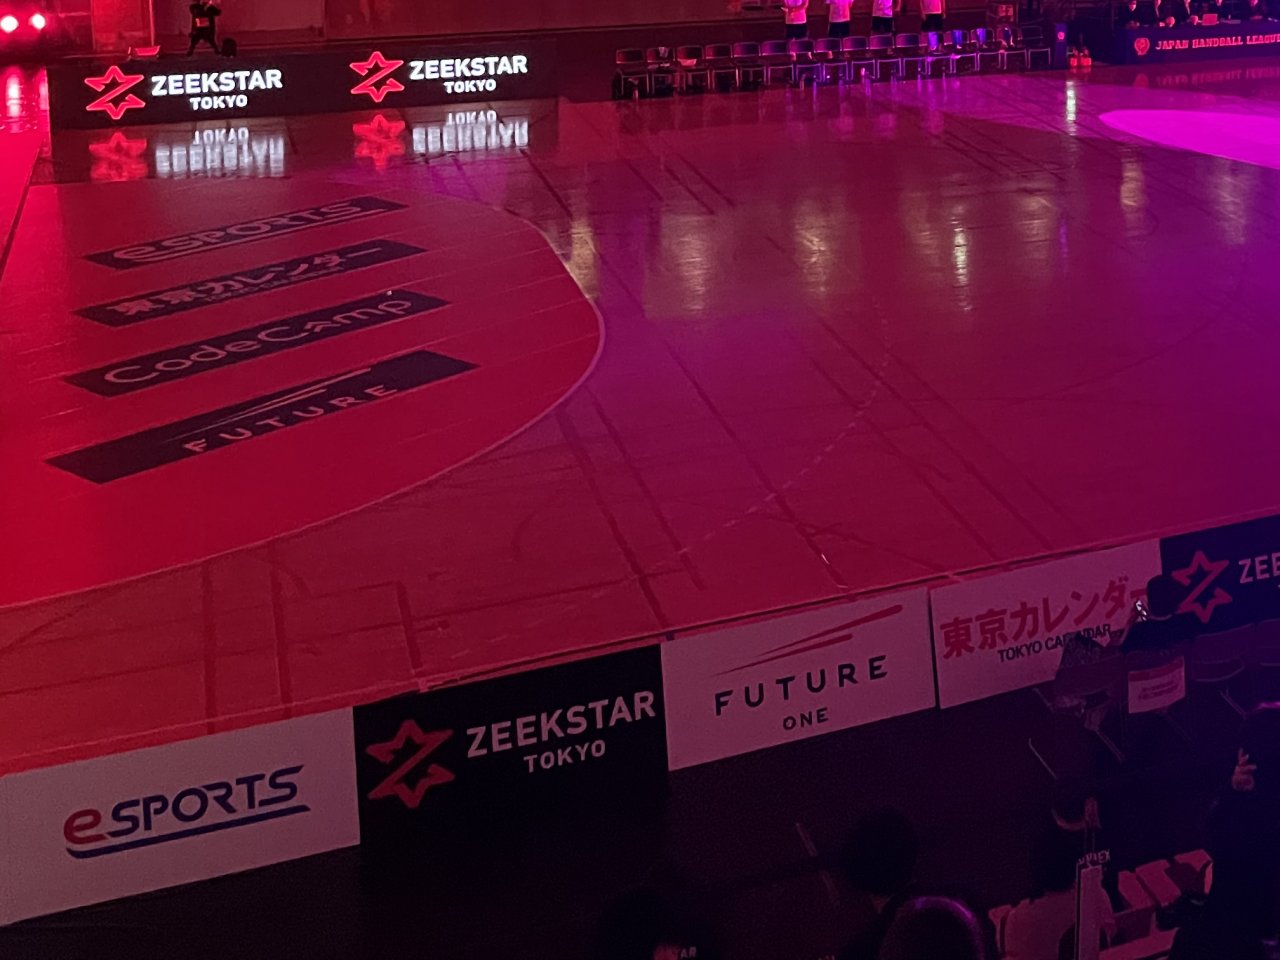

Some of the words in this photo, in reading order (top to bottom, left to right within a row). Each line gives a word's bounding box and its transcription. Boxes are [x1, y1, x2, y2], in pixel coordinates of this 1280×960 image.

[1155, 38, 1189, 51] JAPAN
[1191, 36, 1244, 49] HANDBALL
[151, 69, 283, 97] ZEEKSTAR
[409, 55, 528, 81] ZEEKSTAR
[443, 78, 497, 95] TOKYO
[189, 94, 249, 112] TOKYO
[112, 201, 363, 262] eSPORTS
[182, 383, 398, 454] FUTURE
[940, 575, 1149, 660] 東京カレンダー
[997, 639, 1043, 663] TOKYO
[1044, 623, 1112, 651] CANDAR
[714, 653, 889, 716] FUTURE
[465, 689, 657, 759] ZEEKSTAR
[781, 706, 830, 732] ONE
[523, 738, 607, 775] TOKYO
[63, 765, 306, 845] eSPORTS
